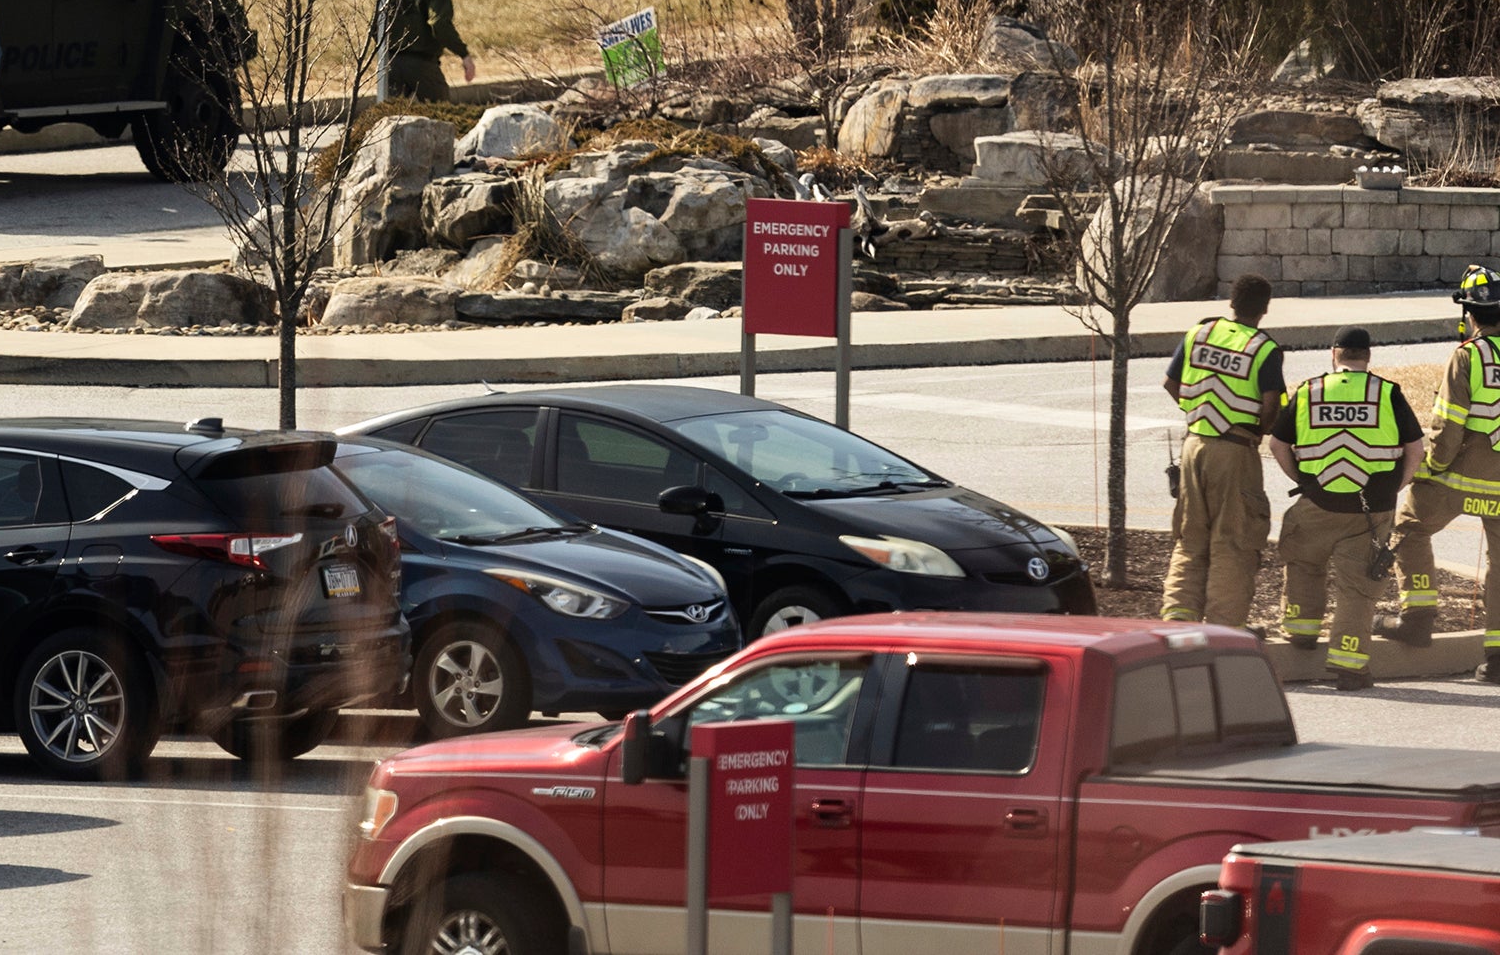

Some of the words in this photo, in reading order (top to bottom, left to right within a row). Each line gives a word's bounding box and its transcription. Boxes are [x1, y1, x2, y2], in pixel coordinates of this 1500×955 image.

[2, 40, 99, 75] POLICE
[753, 221, 830, 238] EMERGENCY
[763, 242, 820, 258] PARKING
[773, 263, 809, 277] ONLY
[1199, 346, 1243, 372] R505
[1318, 406, 1369, 422] R505
[1411, 574, 1430, 589] 50
[1341, 635, 1360, 652] 50
[717, 750, 789, 770] EMERGENCY
[726, 776, 780, 795] PARKING
[735, 803, 770, 821] ONLY
